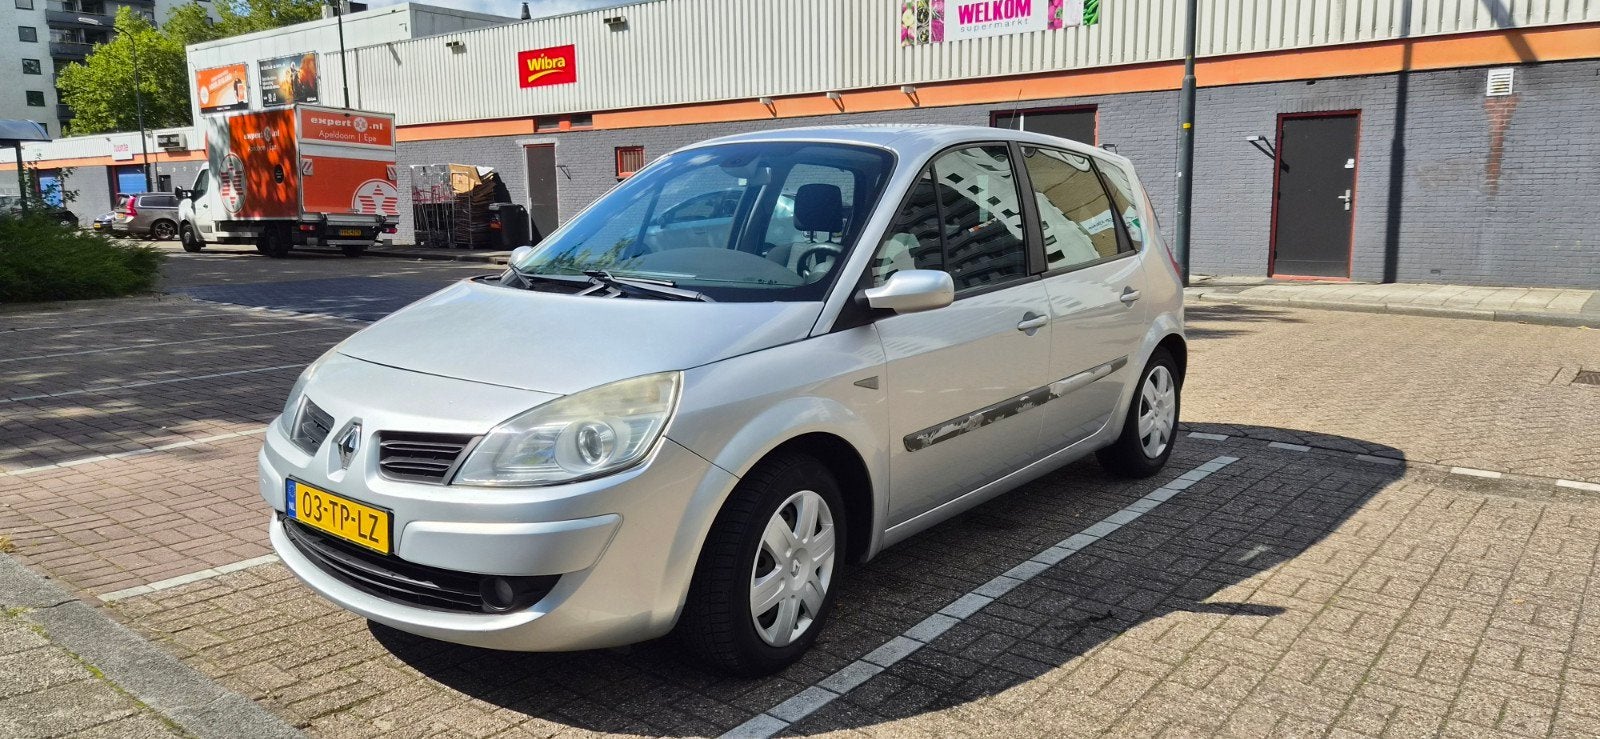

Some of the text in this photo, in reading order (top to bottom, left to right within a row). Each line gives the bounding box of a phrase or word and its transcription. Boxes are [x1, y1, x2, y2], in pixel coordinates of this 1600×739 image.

[958, 0, 1031, 25] WELKOM
[960, 19, 1028, 32] supermarkt
[527, 53, 566, 71] Wibra
[310, 117, 352, 127] expert
[363, 133, 377, 144] Epe
[302, 491, 379, 544] 03-TP-LZ
